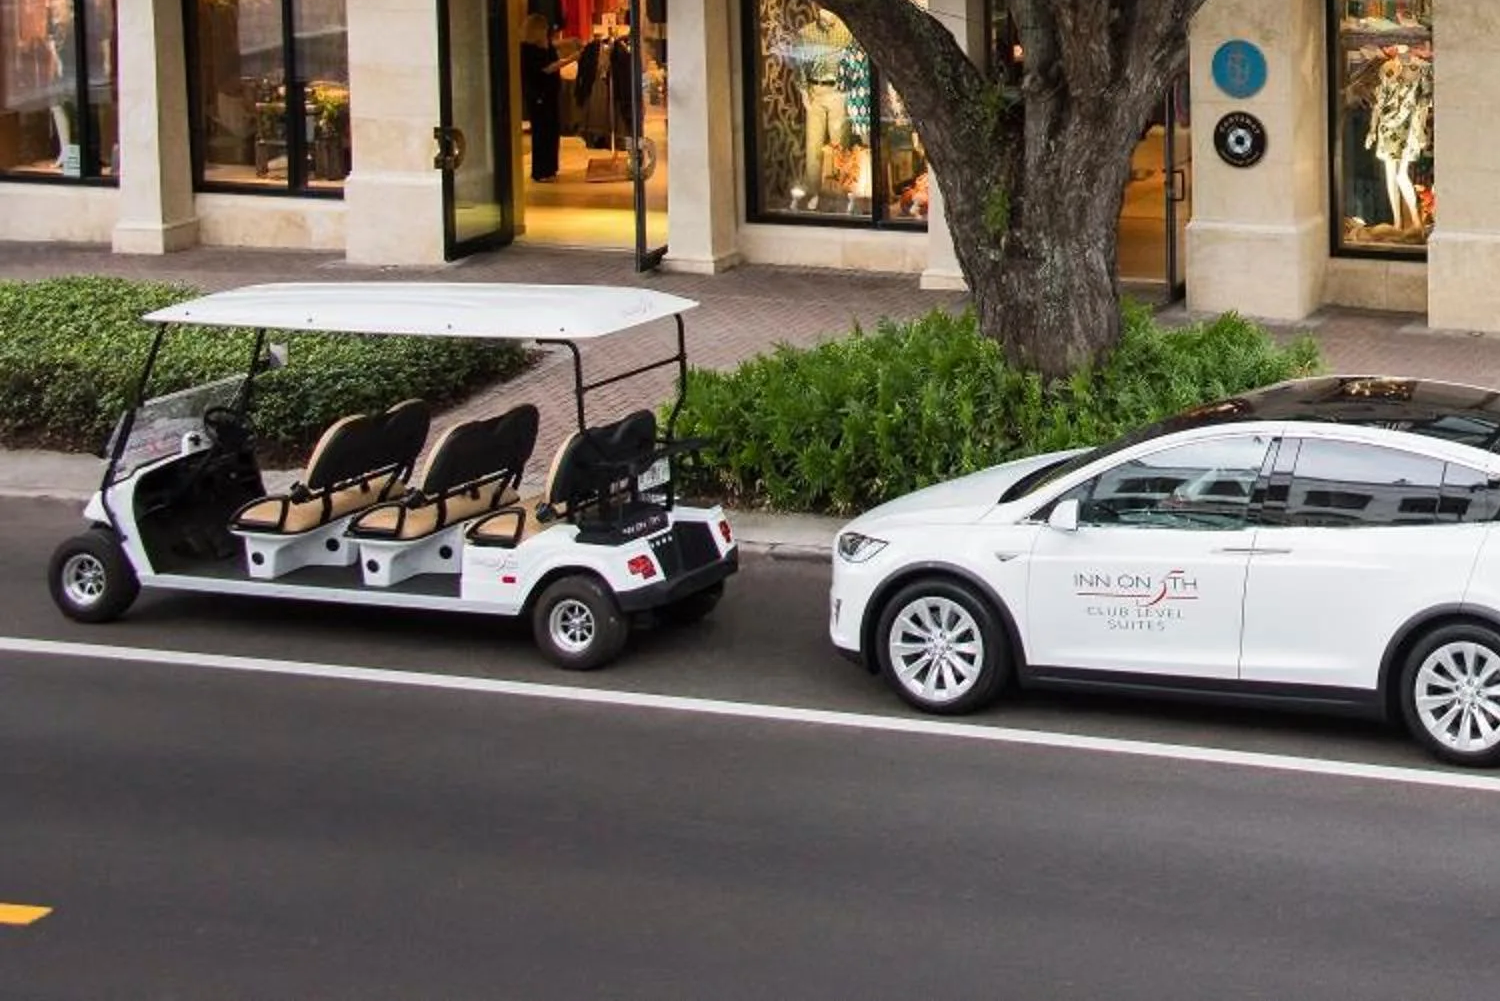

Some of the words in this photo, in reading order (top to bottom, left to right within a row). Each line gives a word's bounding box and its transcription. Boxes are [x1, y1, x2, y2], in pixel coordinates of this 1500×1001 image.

[1074, 574, 1111, 588] INN
[1117, 575, 1151, 589] ON
[1087, 606, 1129, 618] CLUB
[1136, 608, 1184, 619] LEVEL
[1107, 619, 1166, 631] SUITES
